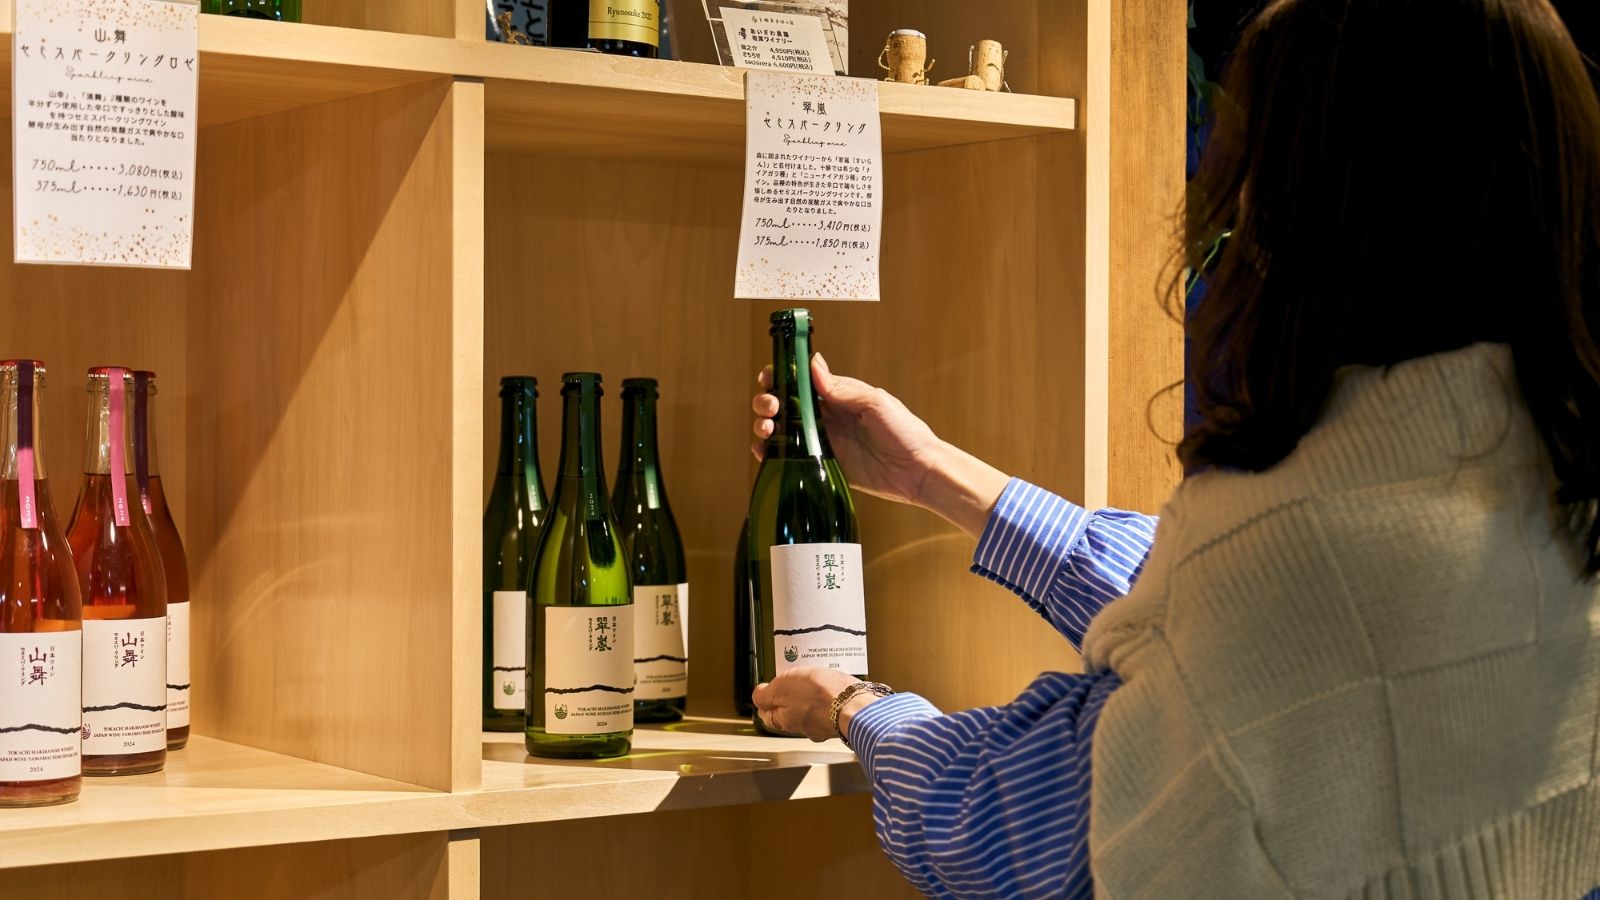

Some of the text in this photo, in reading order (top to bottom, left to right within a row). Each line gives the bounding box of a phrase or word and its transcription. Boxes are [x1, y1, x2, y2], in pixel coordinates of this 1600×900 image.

[608, 7, 640, 17] Ryunosuke
[94, 28, 127, 44] 山舞
[20, 44, 195, 71] セミスパークリングロゼ
[65, 66, 123, 83] Sparkling
[50, 112, 167, 127] を持つセミスパークリングワイン
[764, 117, 866, 134] セミスパークリング
[71, 134, 146, 146] 当たりとなりました。
[783, 134, 824, 147] Sparkling
[786, 206, 837, 215] たりとなりました。
[823, 554, 840, 590] 翠嵐
[595, 616, 612, 651] 翠嵐
[121, 632, 138, 667] 山舞
[28, 647, 48, 686] 山舞
